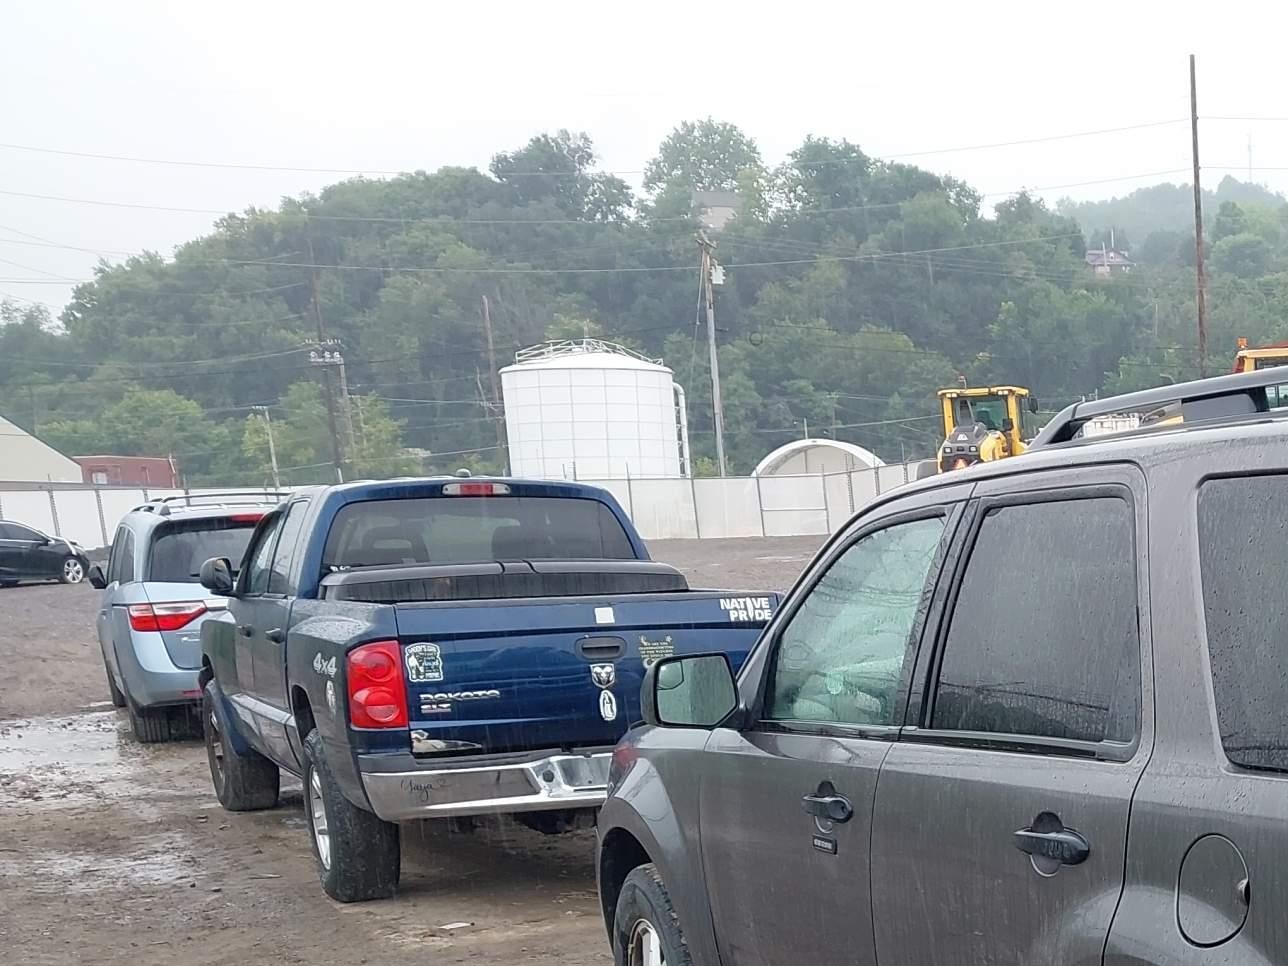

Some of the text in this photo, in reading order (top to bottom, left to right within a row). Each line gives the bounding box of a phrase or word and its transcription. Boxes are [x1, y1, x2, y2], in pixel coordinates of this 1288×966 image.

[720, 597, 769, 610] NATIVE
[729, 609, 773, 622] PRIDE
[313, 652, 337, 675] 4x4
